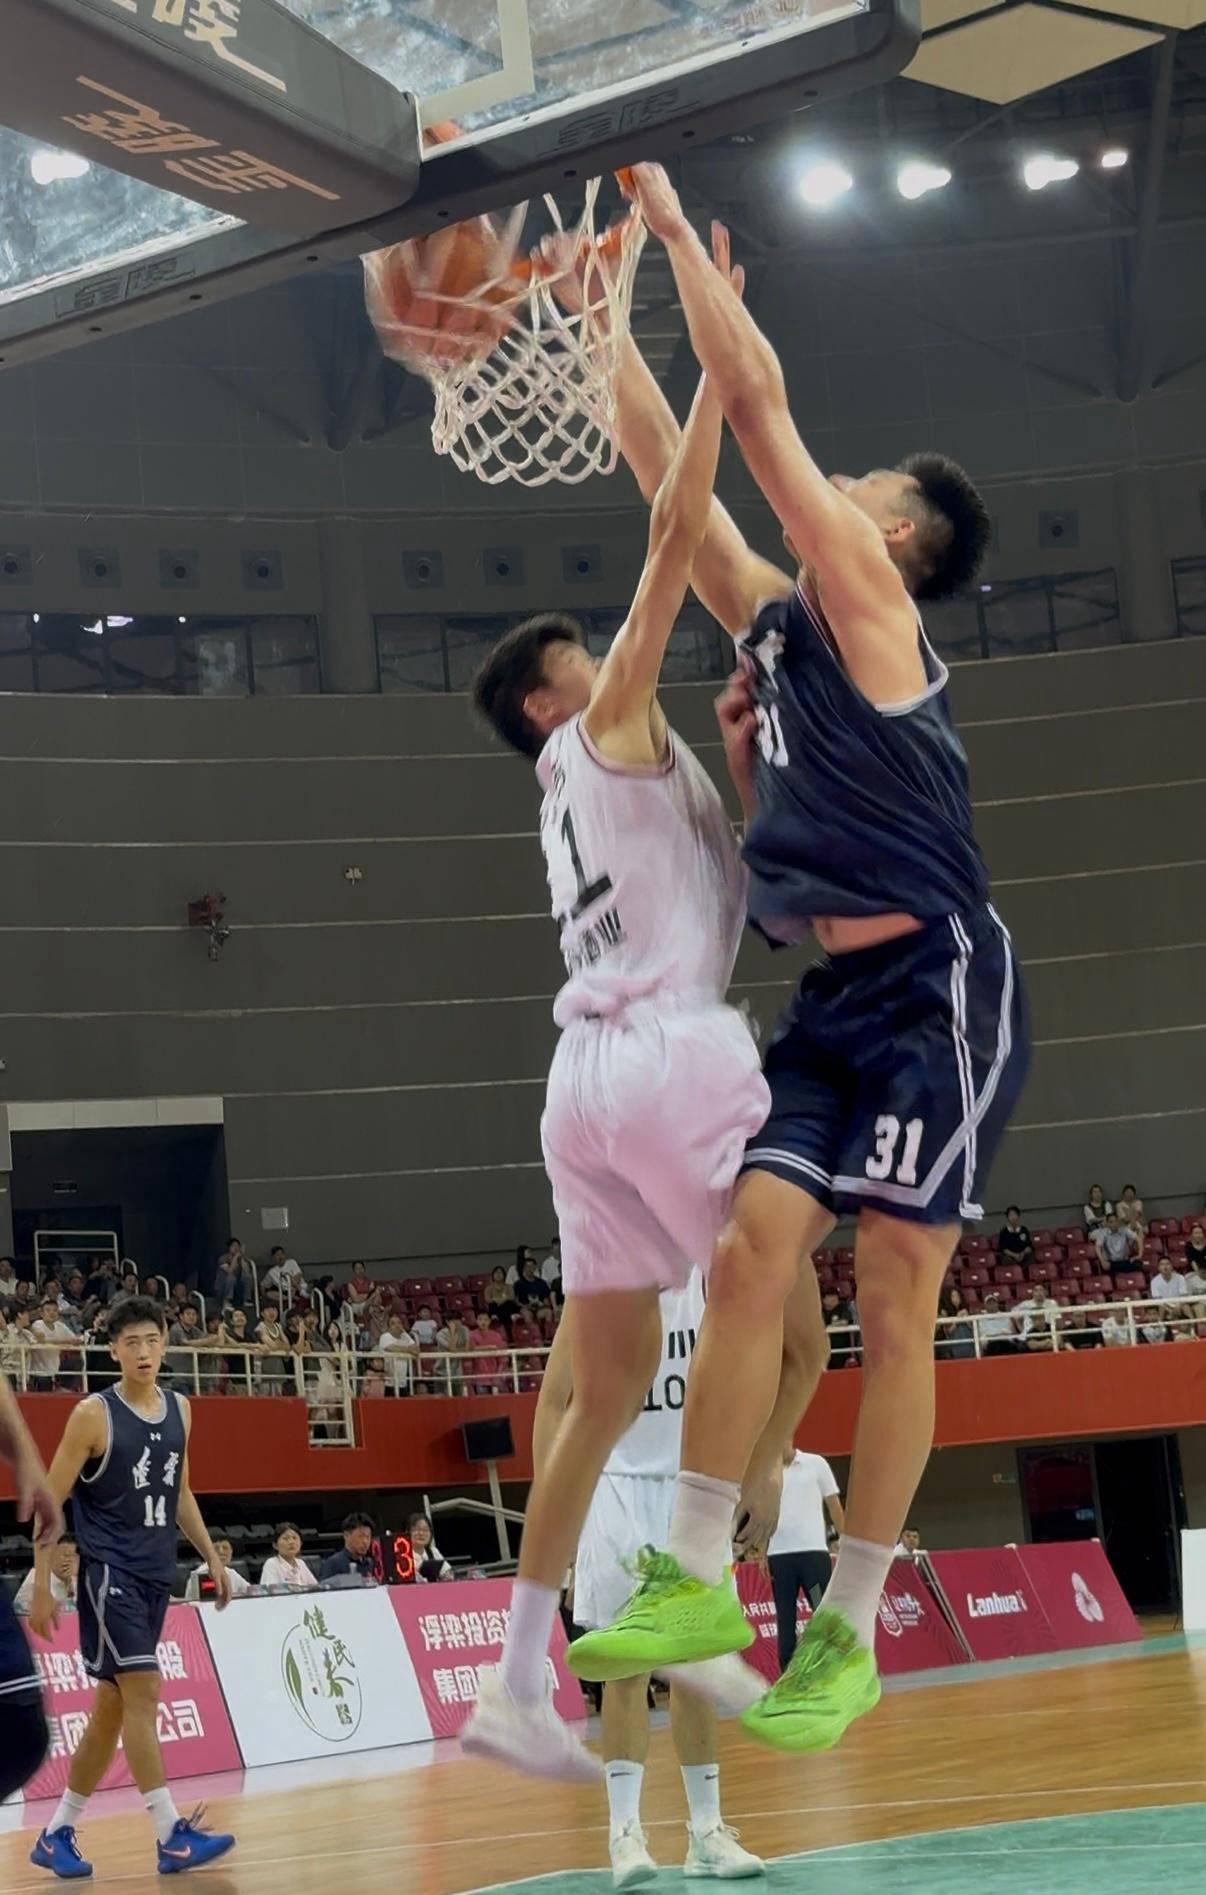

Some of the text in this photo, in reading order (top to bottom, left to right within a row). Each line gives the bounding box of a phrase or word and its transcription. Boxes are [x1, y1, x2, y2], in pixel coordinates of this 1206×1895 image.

[866, 1114, 924, 1186] 31
[643, 1374, 686, 1411] 10
[143, 1495, 167, 1527] 14
[393, 1536, 413, 1578] 3
